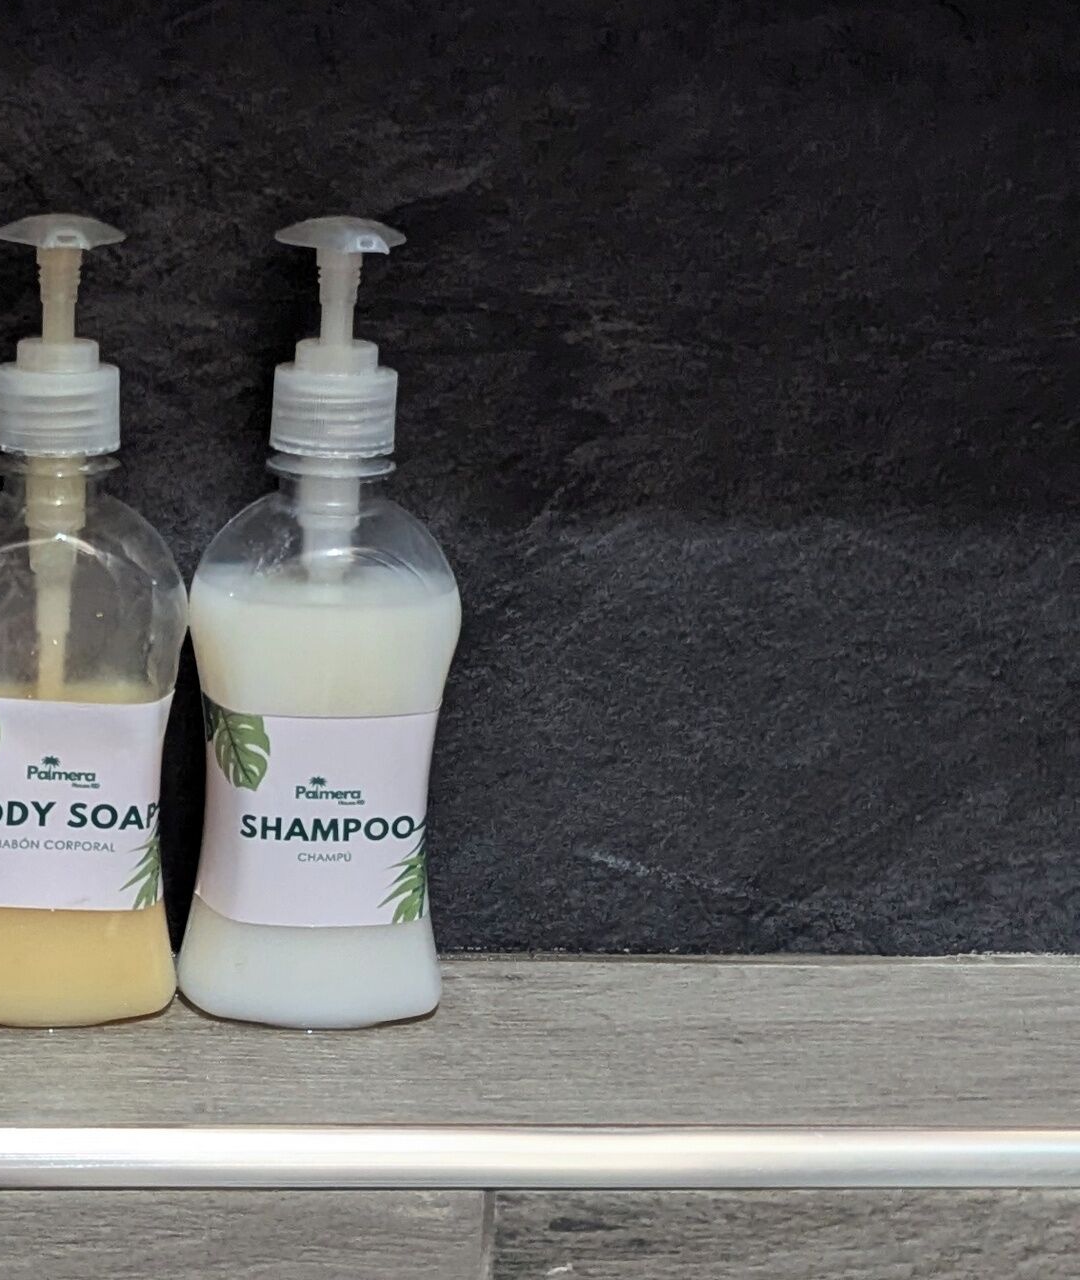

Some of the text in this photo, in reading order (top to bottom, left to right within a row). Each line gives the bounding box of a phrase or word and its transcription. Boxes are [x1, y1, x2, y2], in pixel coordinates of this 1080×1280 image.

[26, 765, 96, 782] Palmera
[295, 785, 362, 800] Palmera
[67, 802, 157, 830] SOAP
[240, 814, 415, 842] SHAMPOO
[43, 839, 115, 853] CORPORAL
[297, 851, 352, 863] CHAMPÚ
